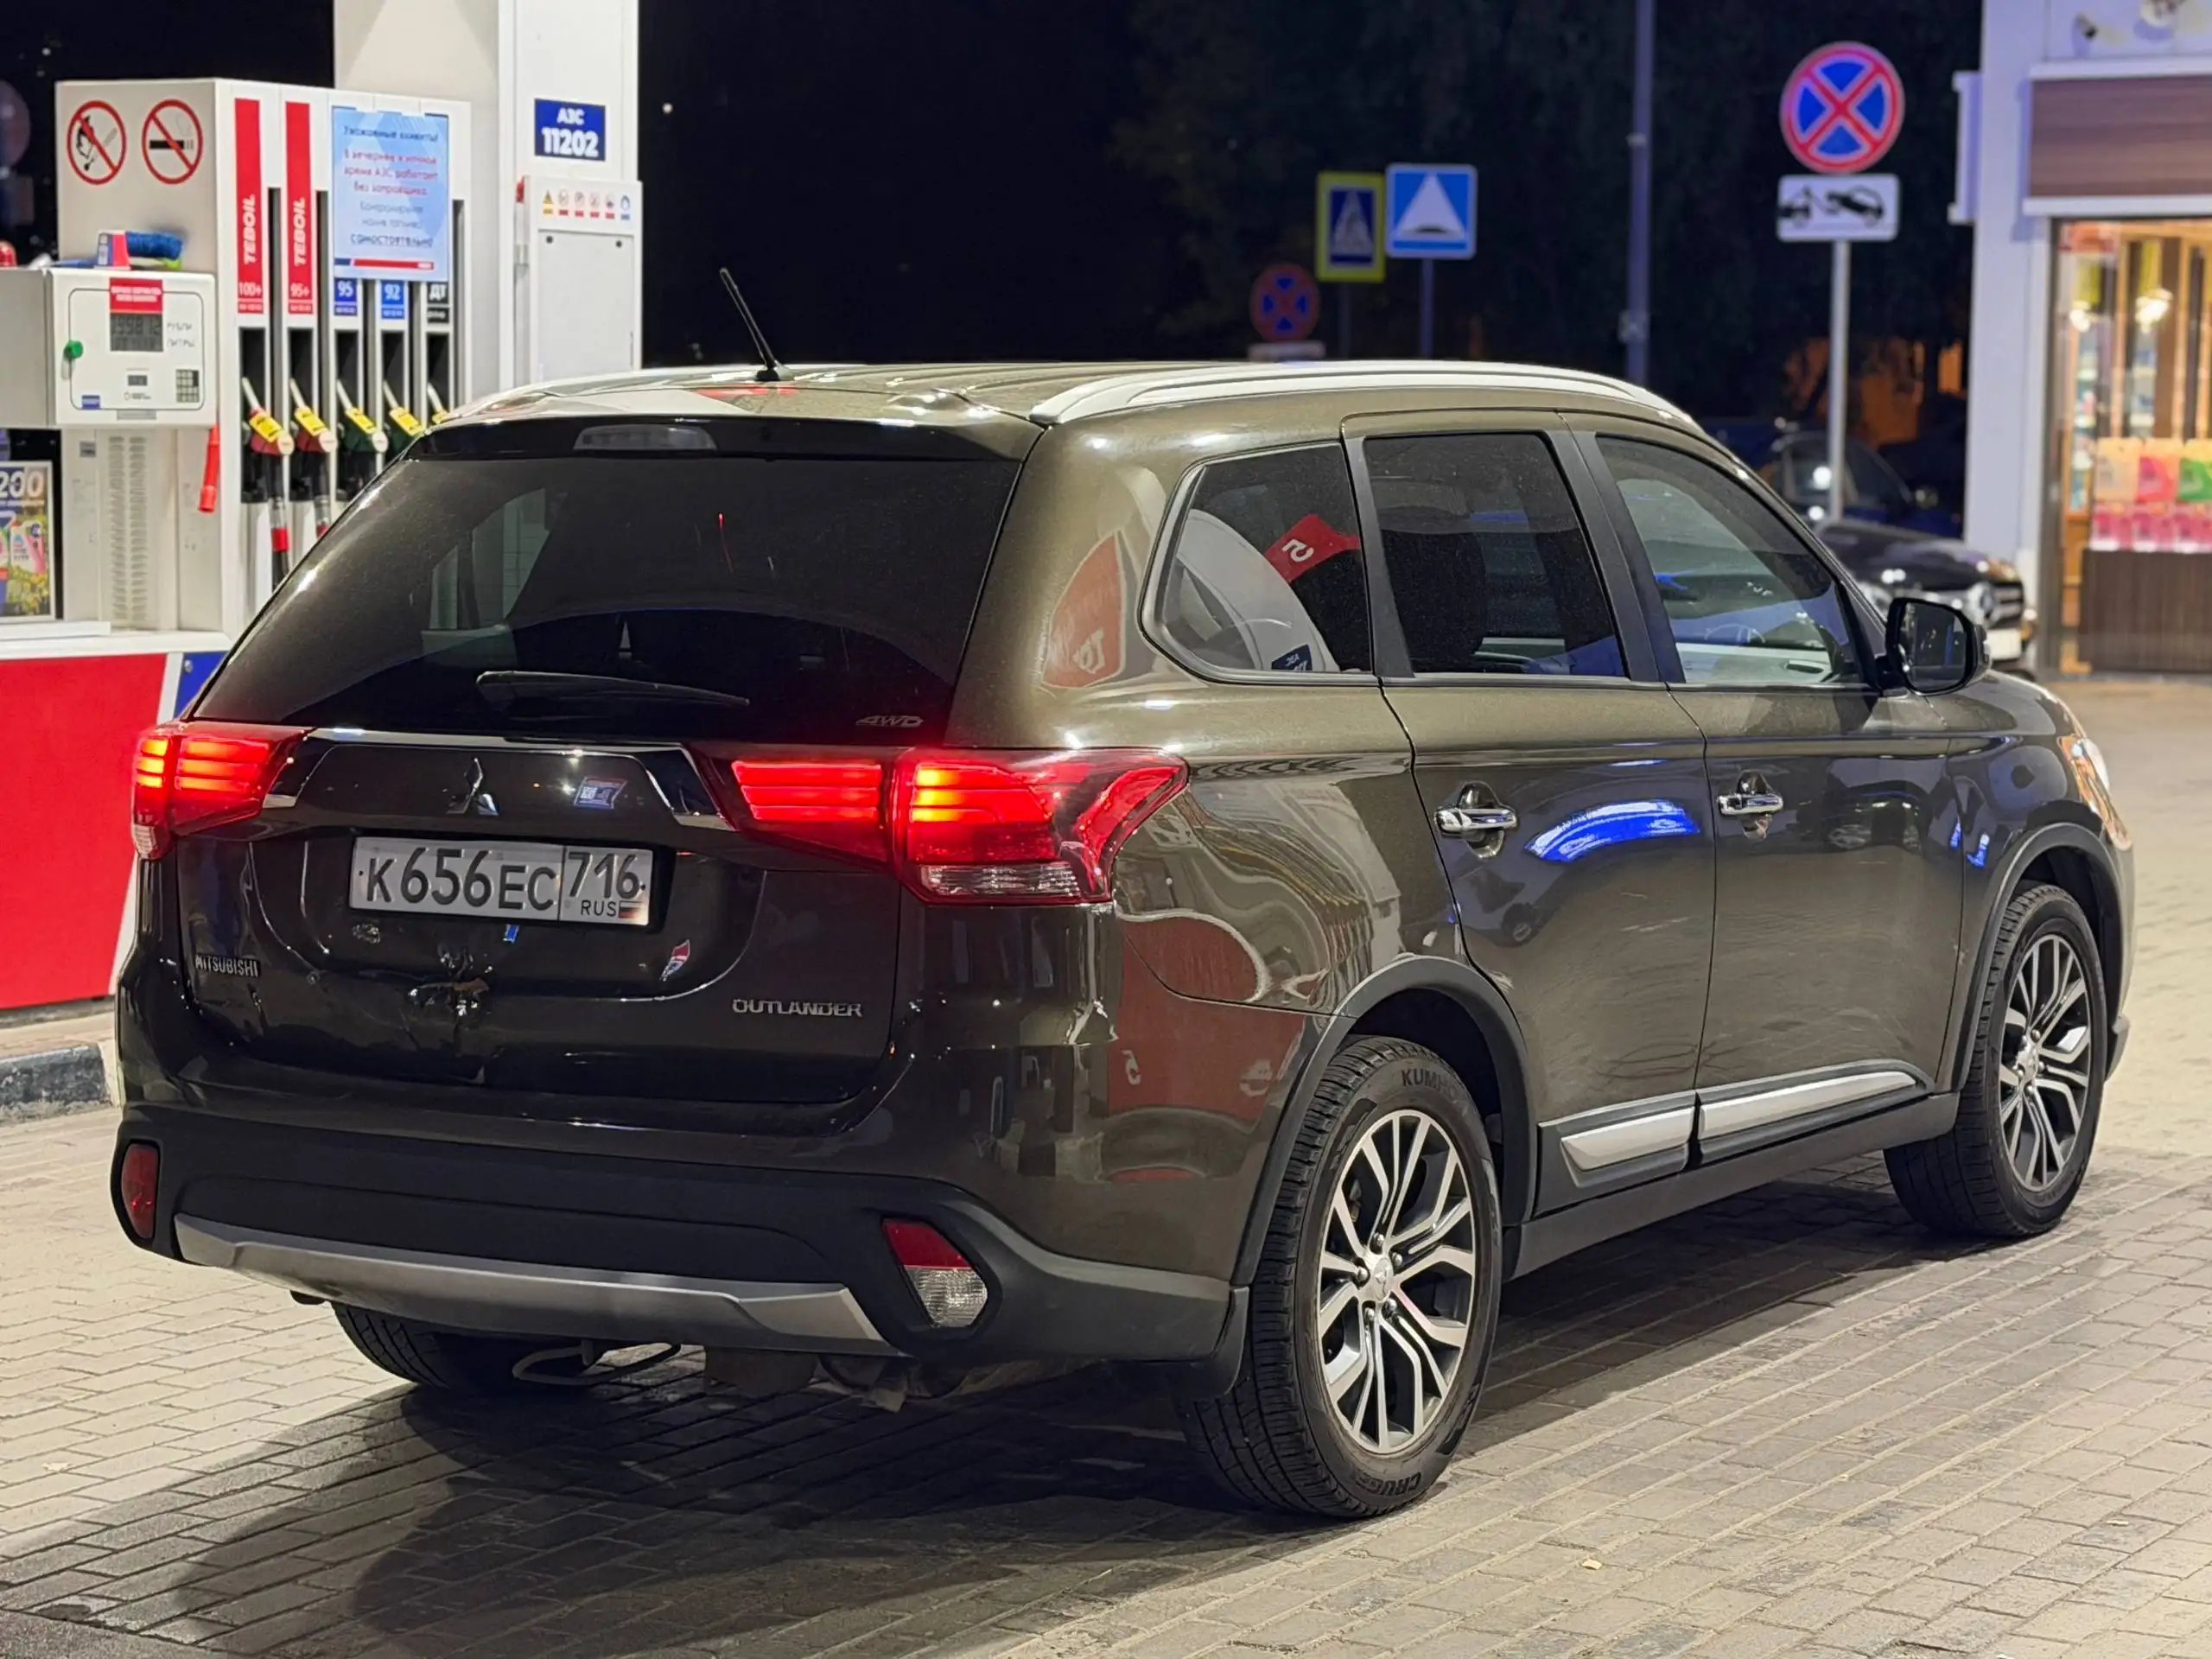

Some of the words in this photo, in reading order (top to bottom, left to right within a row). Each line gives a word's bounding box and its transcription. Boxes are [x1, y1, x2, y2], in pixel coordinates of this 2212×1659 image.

[556, 107, 585, 125] АЗС
[541, 126, 599, 157] 11202
[243, 194, 257, 265] TEBOIL
[293, 197, 306, 267] TEBOIL
[238, 282, 261, 296] 100+
[289, 283, 310, 297] 95+
[338, 280, 353, 297] 95
[385, 283, 400, 301] 92
[429, 284, 447, 301] ДТ
[855, 715, 924, 728] 4WD
[569, 851, 641, 899] 716
[581, 899, 617, 918] RUS
[195, 954, 258, 977] MITSUBISHI
[733, 999, 862, 1017] OUTLANDER
